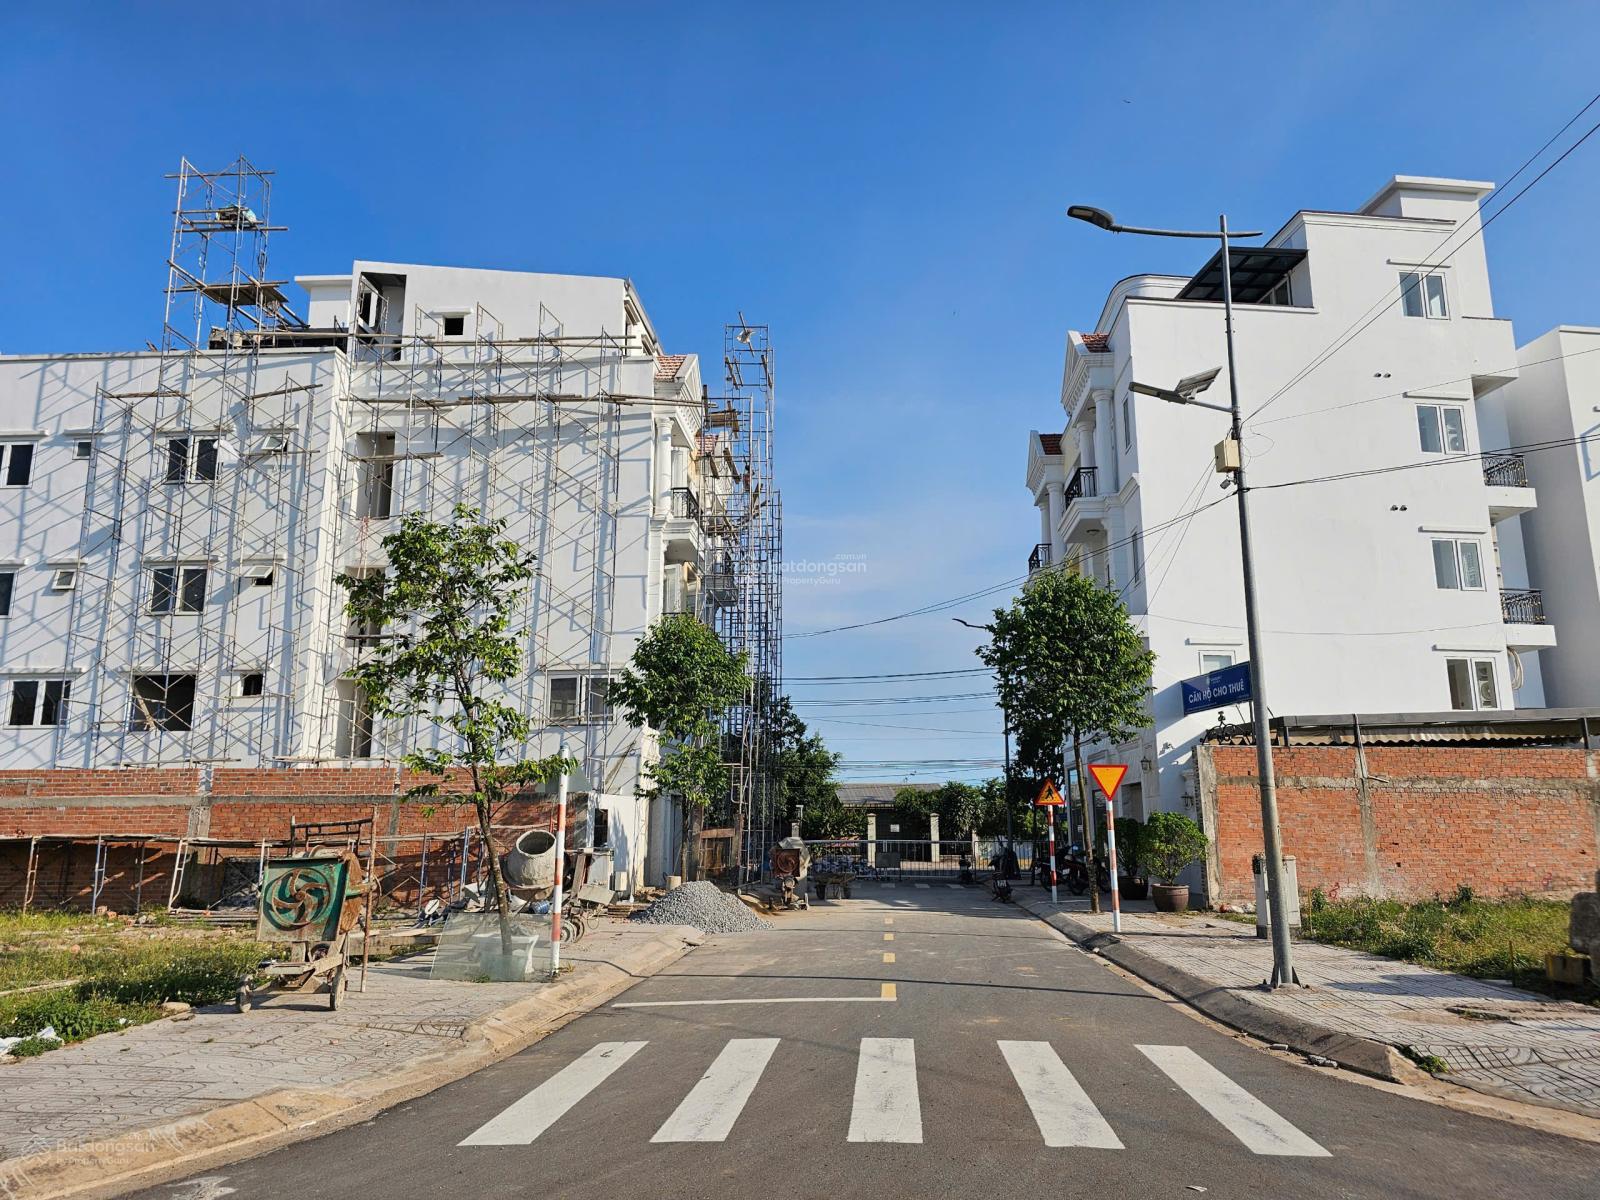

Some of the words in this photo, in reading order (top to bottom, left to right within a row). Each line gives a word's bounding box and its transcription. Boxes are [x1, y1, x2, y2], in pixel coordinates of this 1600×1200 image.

[1188, 691, 1201, 703] CĂN
[1202, 687, 1212, 702] HỘ
[1212, 686, 1228, 698] CHO
[1228, 678, 1244, 694] THUÊ
